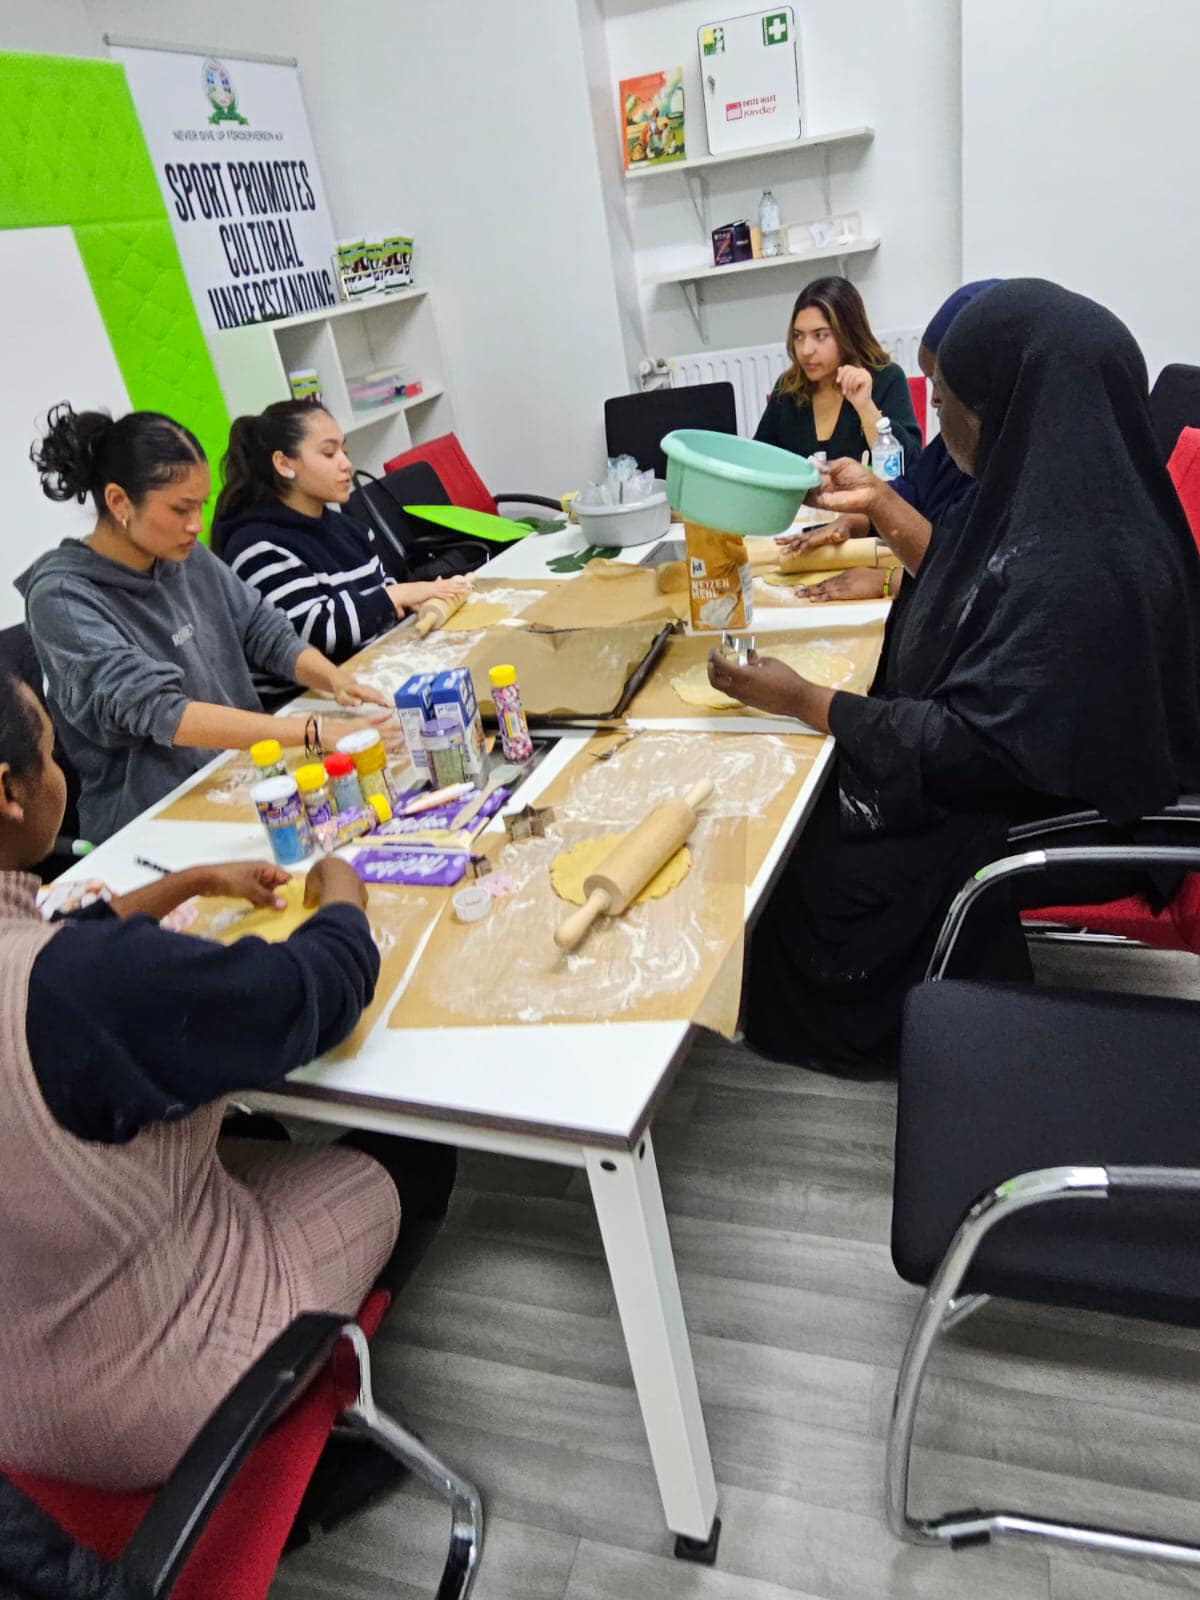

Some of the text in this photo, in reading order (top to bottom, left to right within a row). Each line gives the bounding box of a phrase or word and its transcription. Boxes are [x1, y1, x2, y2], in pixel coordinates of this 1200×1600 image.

[164, 160, 316, 222] SPORT PROMOTES
[218, 218, 304, 279] CULTURAL
